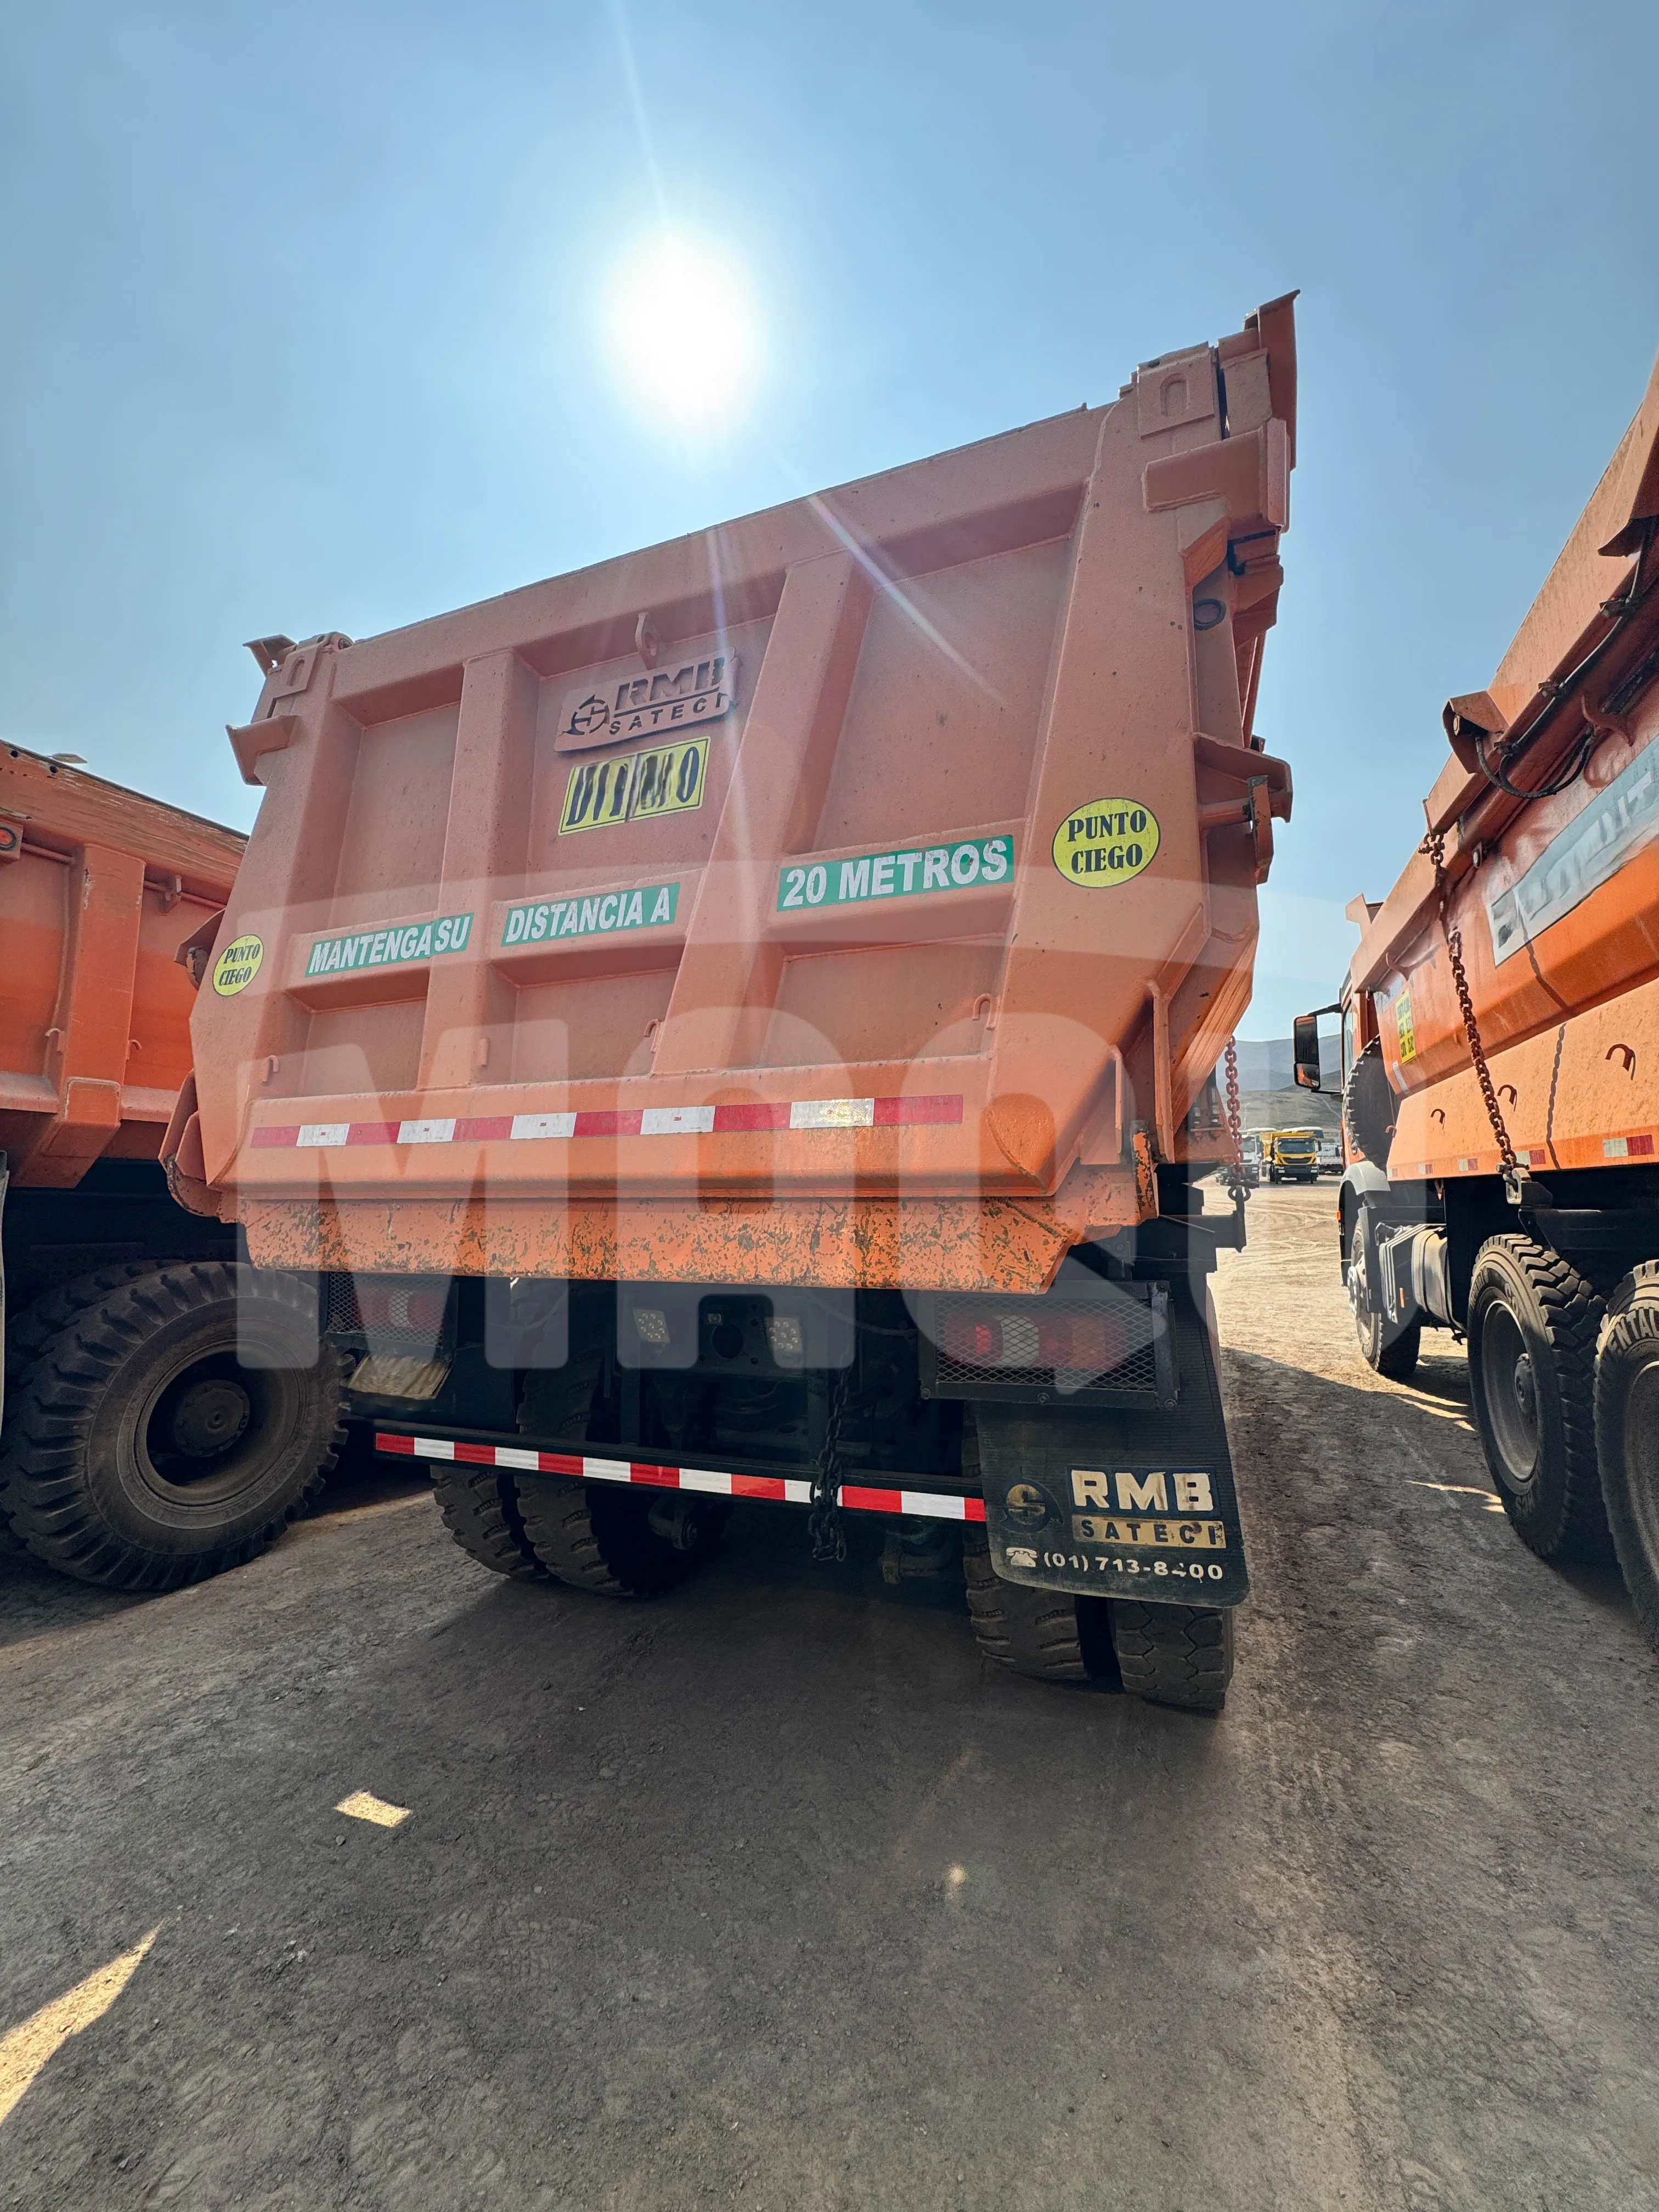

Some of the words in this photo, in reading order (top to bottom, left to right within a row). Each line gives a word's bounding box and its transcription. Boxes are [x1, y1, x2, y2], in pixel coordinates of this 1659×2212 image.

[614, 657, 725, 711] RMB
[1067, 809, 1147, 843] PUNTO
[1071, 843, 1143, 874] CIEGO
[308, 925, 432, 974] MANTENGA
[435, 916, 471, 952] SU
[505, 891, 643, 943] DISTANCIA
[650, 887, 670, 923] A
[782, 866, 827, 907] 20
[838, 839, 1007, 900] METROS
[223, 943, 261, 964] PUNTO
[218, 966, 252, 986] CIEGO
[1071, 1469, 1214, 1511] RMB
[1081, 1519, 1217, 1545] SATECI
[1043, 1551, 1088, 1572] (01)
